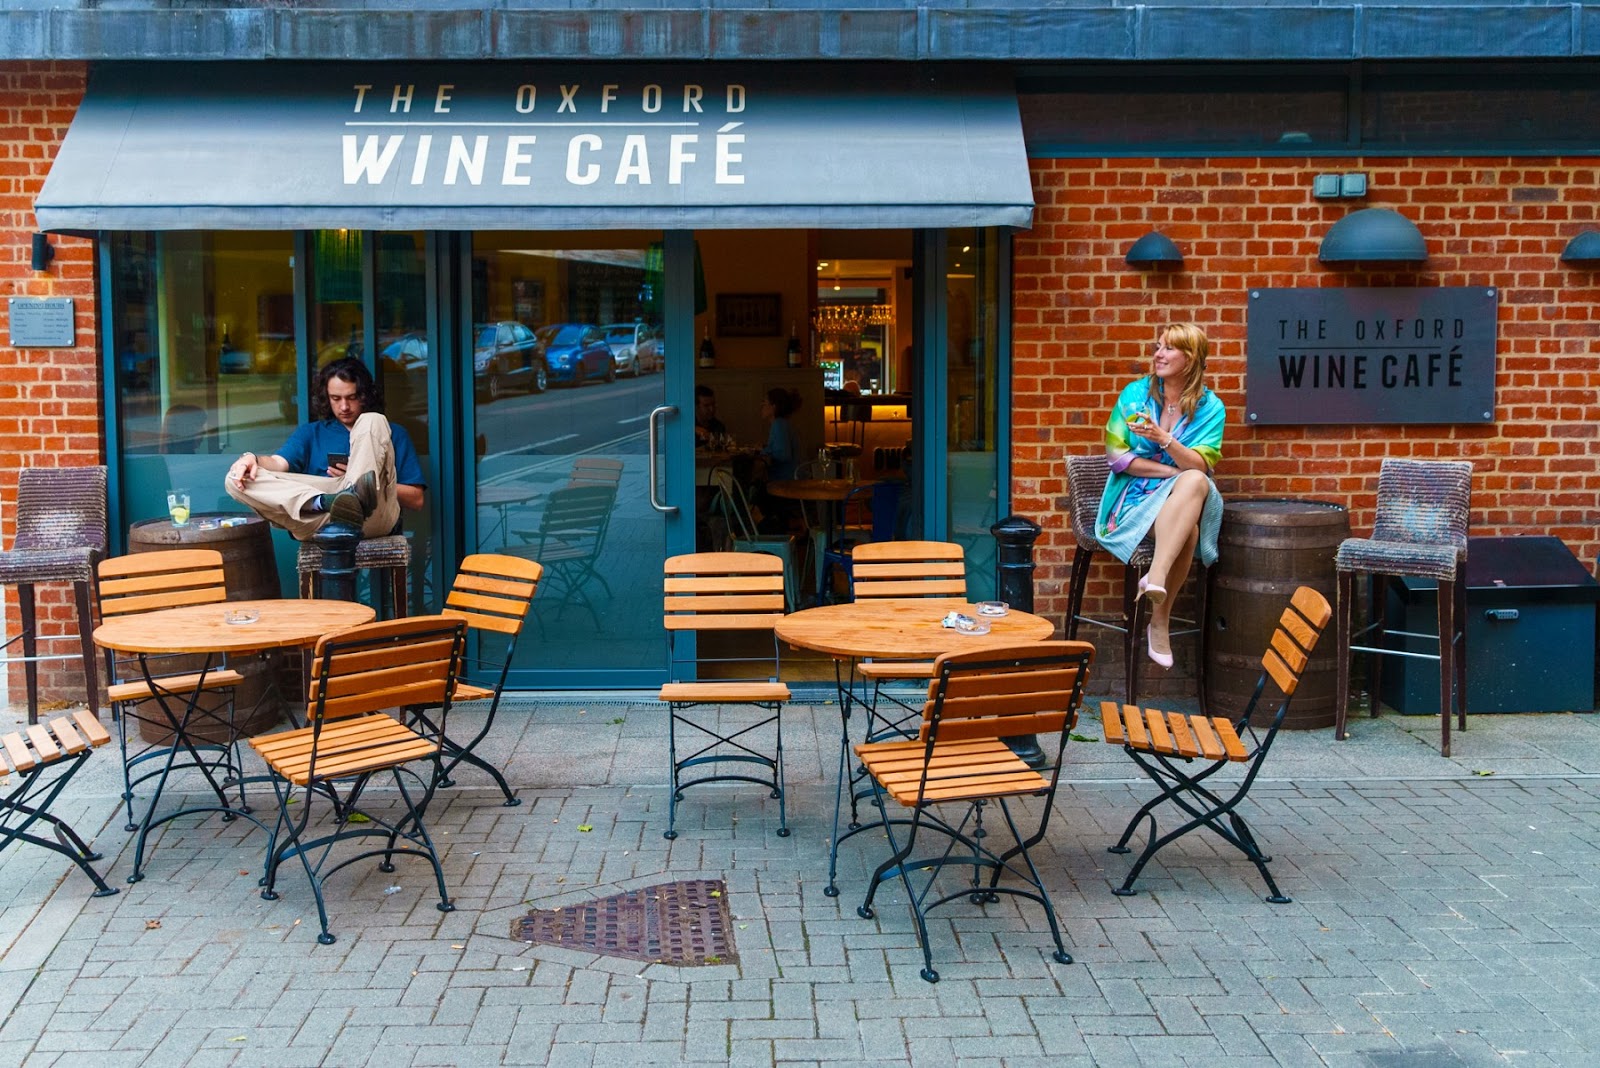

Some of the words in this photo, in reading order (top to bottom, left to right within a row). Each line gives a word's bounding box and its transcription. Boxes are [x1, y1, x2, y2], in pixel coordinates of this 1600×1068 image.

[353, 84, 455, 114] THE
[515, 84, 746, 114] OXFORD
[342, 134, 537, 186] WINE
[565, 122, 746, 186] CAFÉ
[1278, 319, 1327, 340] THE
[1355, 318, 1464, 341] OXFORD
[1278, 354, 1368, 389] WINE
[1381, 345, 1464, 389] CAFÉ
